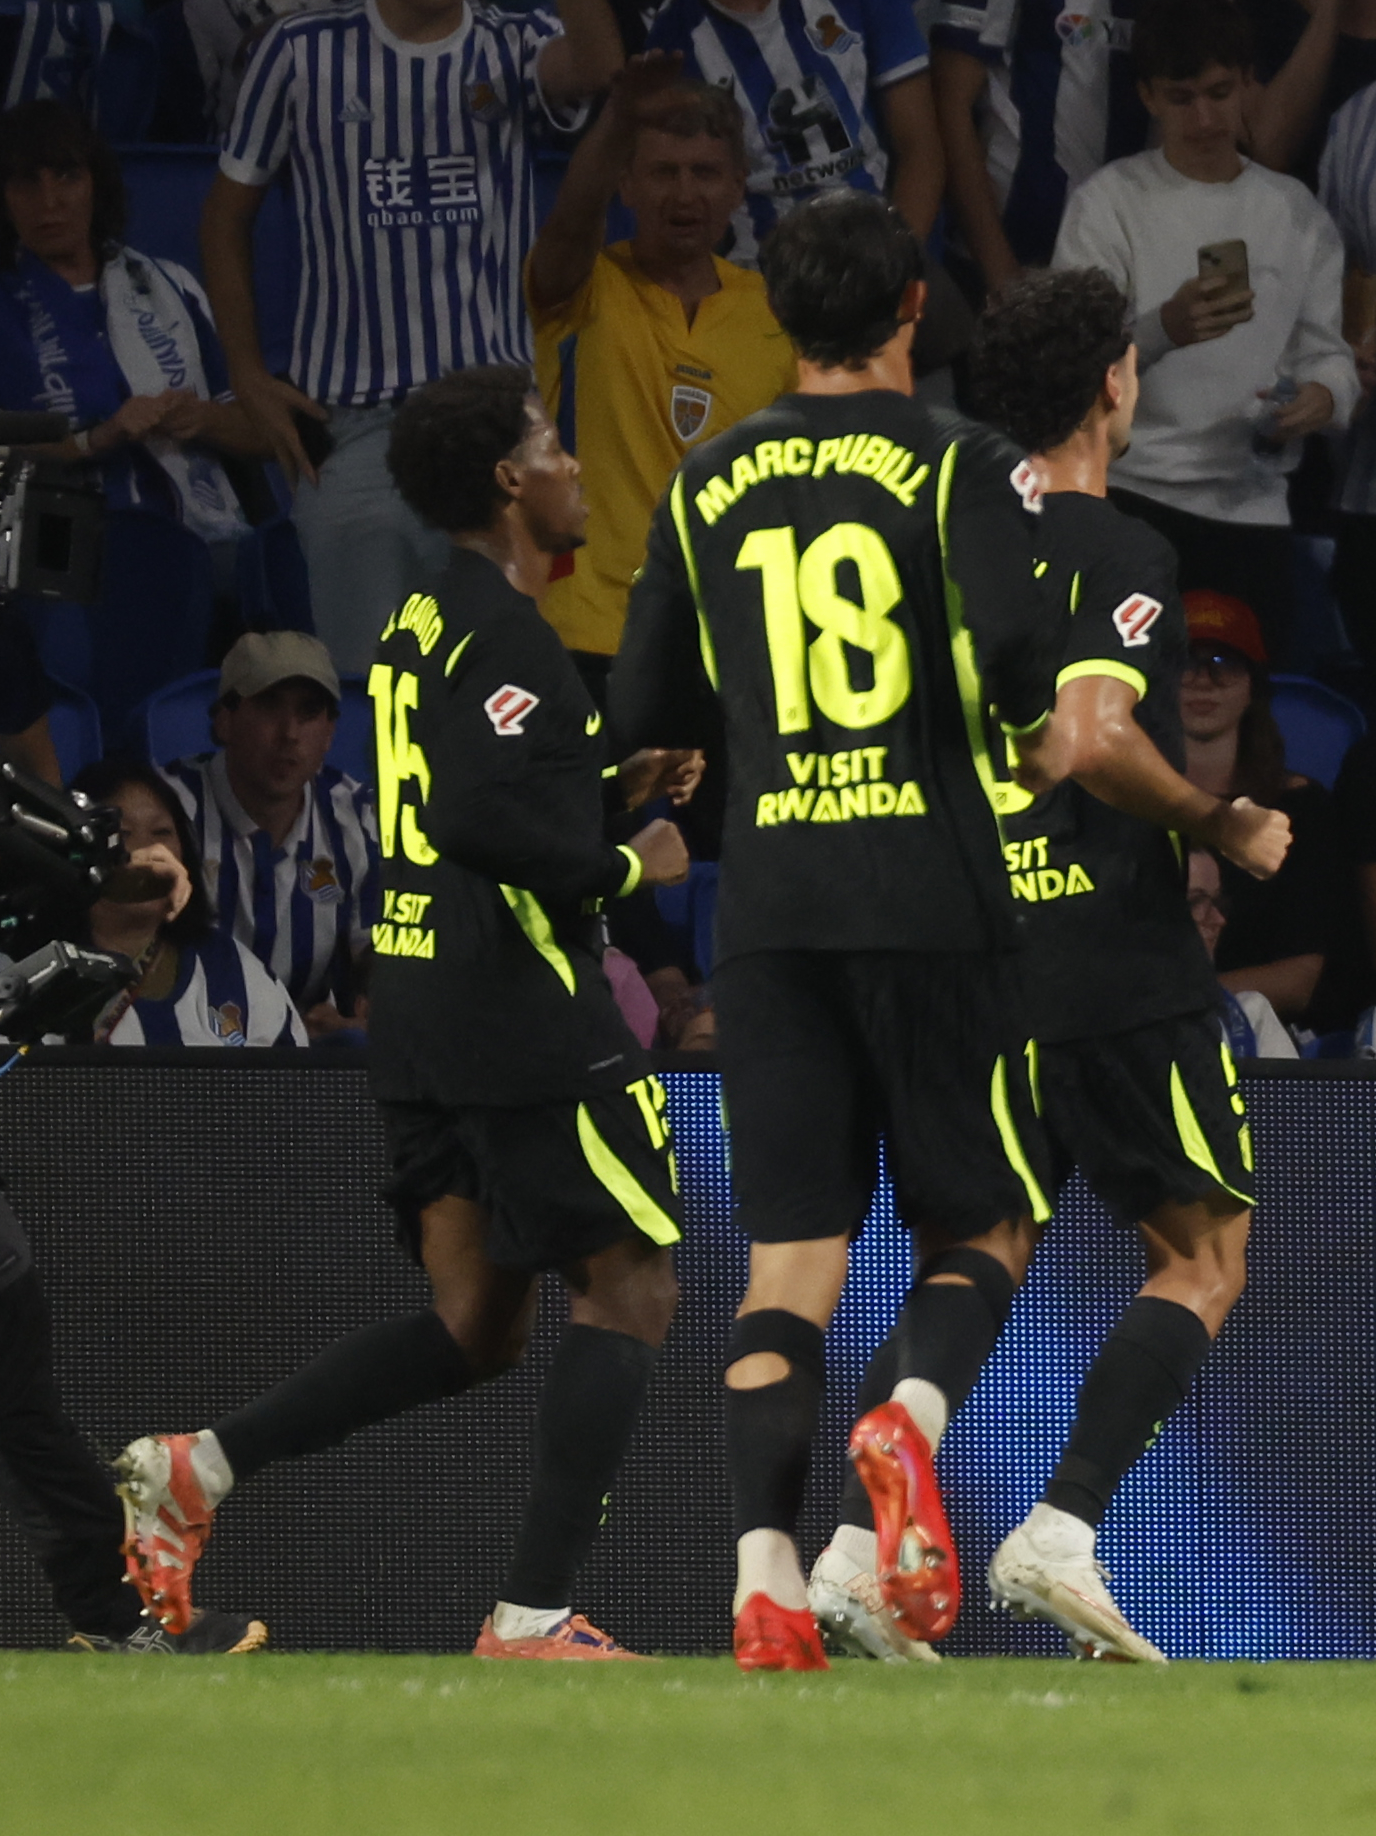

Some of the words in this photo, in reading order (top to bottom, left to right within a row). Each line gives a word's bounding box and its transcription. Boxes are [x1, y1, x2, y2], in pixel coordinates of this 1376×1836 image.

[364, 155, 477, 207] 钱宝
[366, 207, 478, 228] qbao.com
[695, 437, 814, 526] MARC
[812, 433, 931, 507] PUBILL
[735, 521, 911, 736] 18
[785, 746, 888, 788] VISIT
[755, 780, 930, 828] RWANDA
[1003, 835, 1049, 873] SIT
